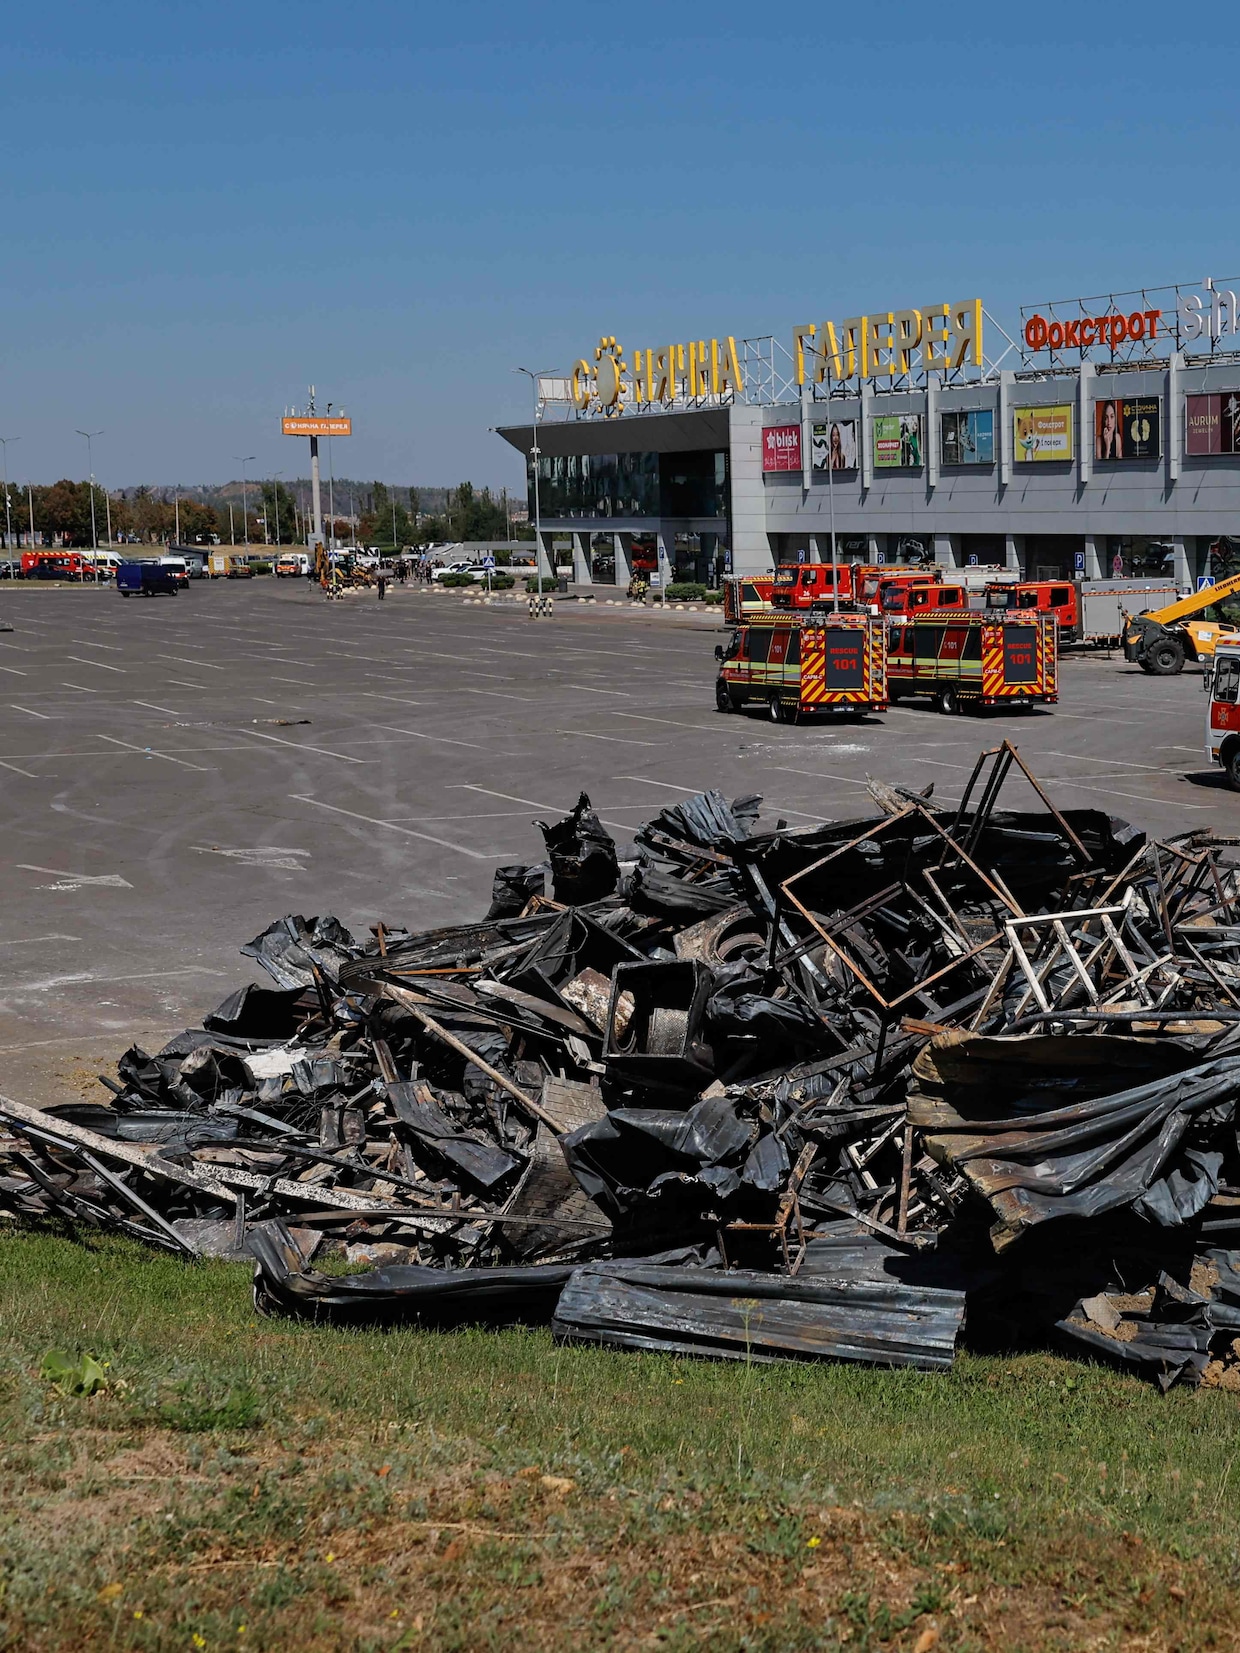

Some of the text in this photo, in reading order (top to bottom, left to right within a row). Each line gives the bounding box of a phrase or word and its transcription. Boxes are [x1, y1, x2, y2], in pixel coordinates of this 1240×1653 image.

[1025, 309, 1163, 351] Фокстрот
[793, 298, 982, 385] ГАЛЕРЕЯ
[1037, 420, 1065, 430] Фокстрот
[1189, 415, 1219, 427] AURUM
[776, 430, 798, 447] blisk
[1077, 554, 1083, 567] P
[833, 659, 857, 670] 101
[1010, 653, 1031, 664] 101
